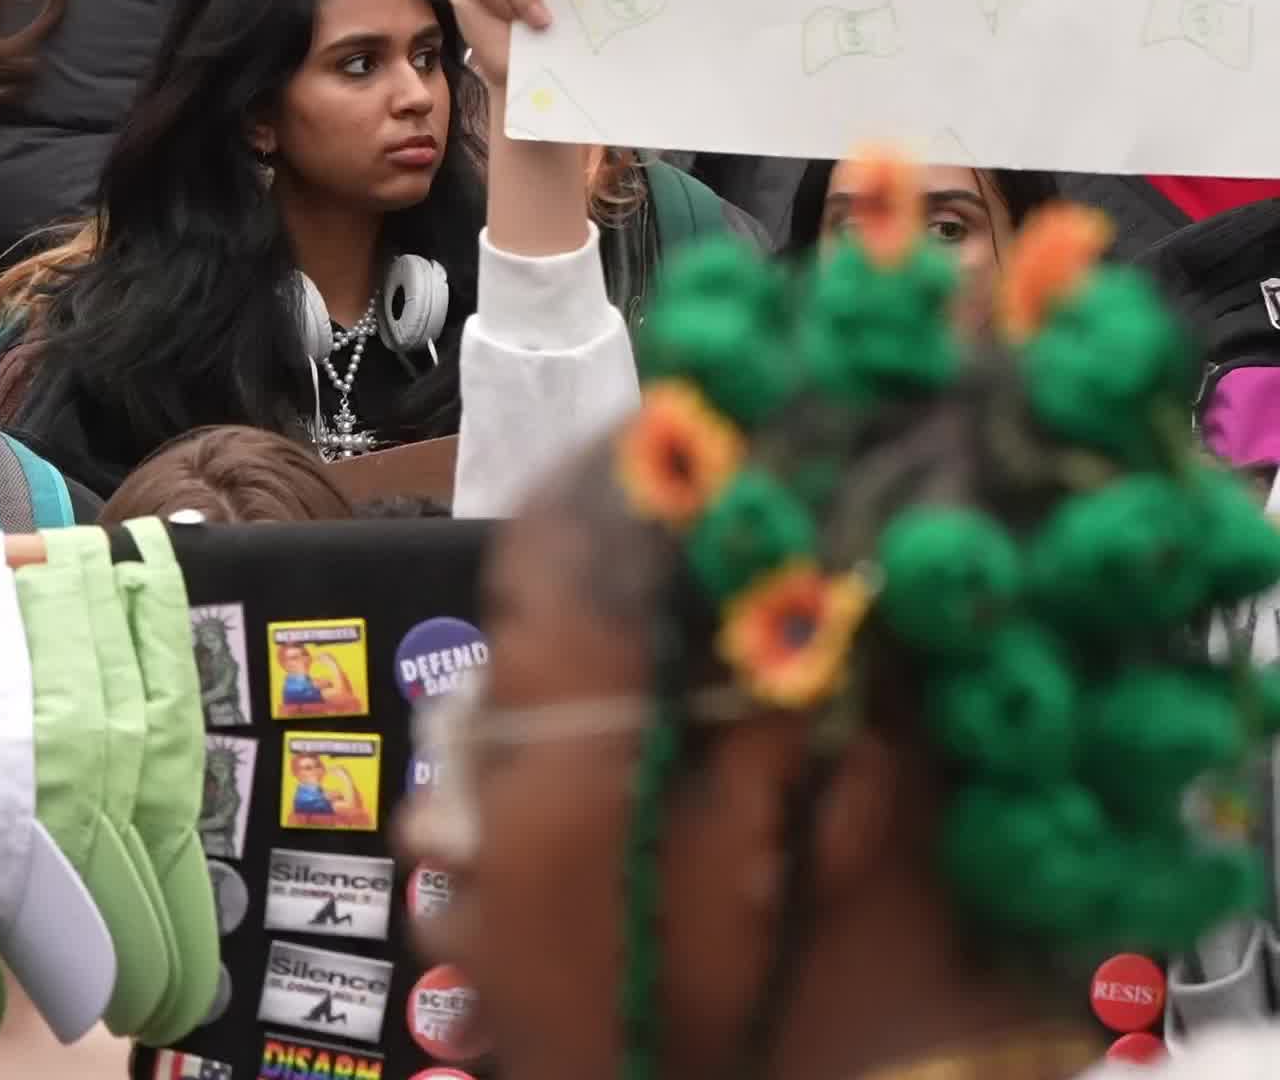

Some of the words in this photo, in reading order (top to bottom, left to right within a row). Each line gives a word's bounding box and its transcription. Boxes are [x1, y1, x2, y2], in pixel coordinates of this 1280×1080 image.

[399, 640, 490, 683] DEFEND
[271, 862, 390, 892] Silence
[269, 957, 388, 995] Silence
